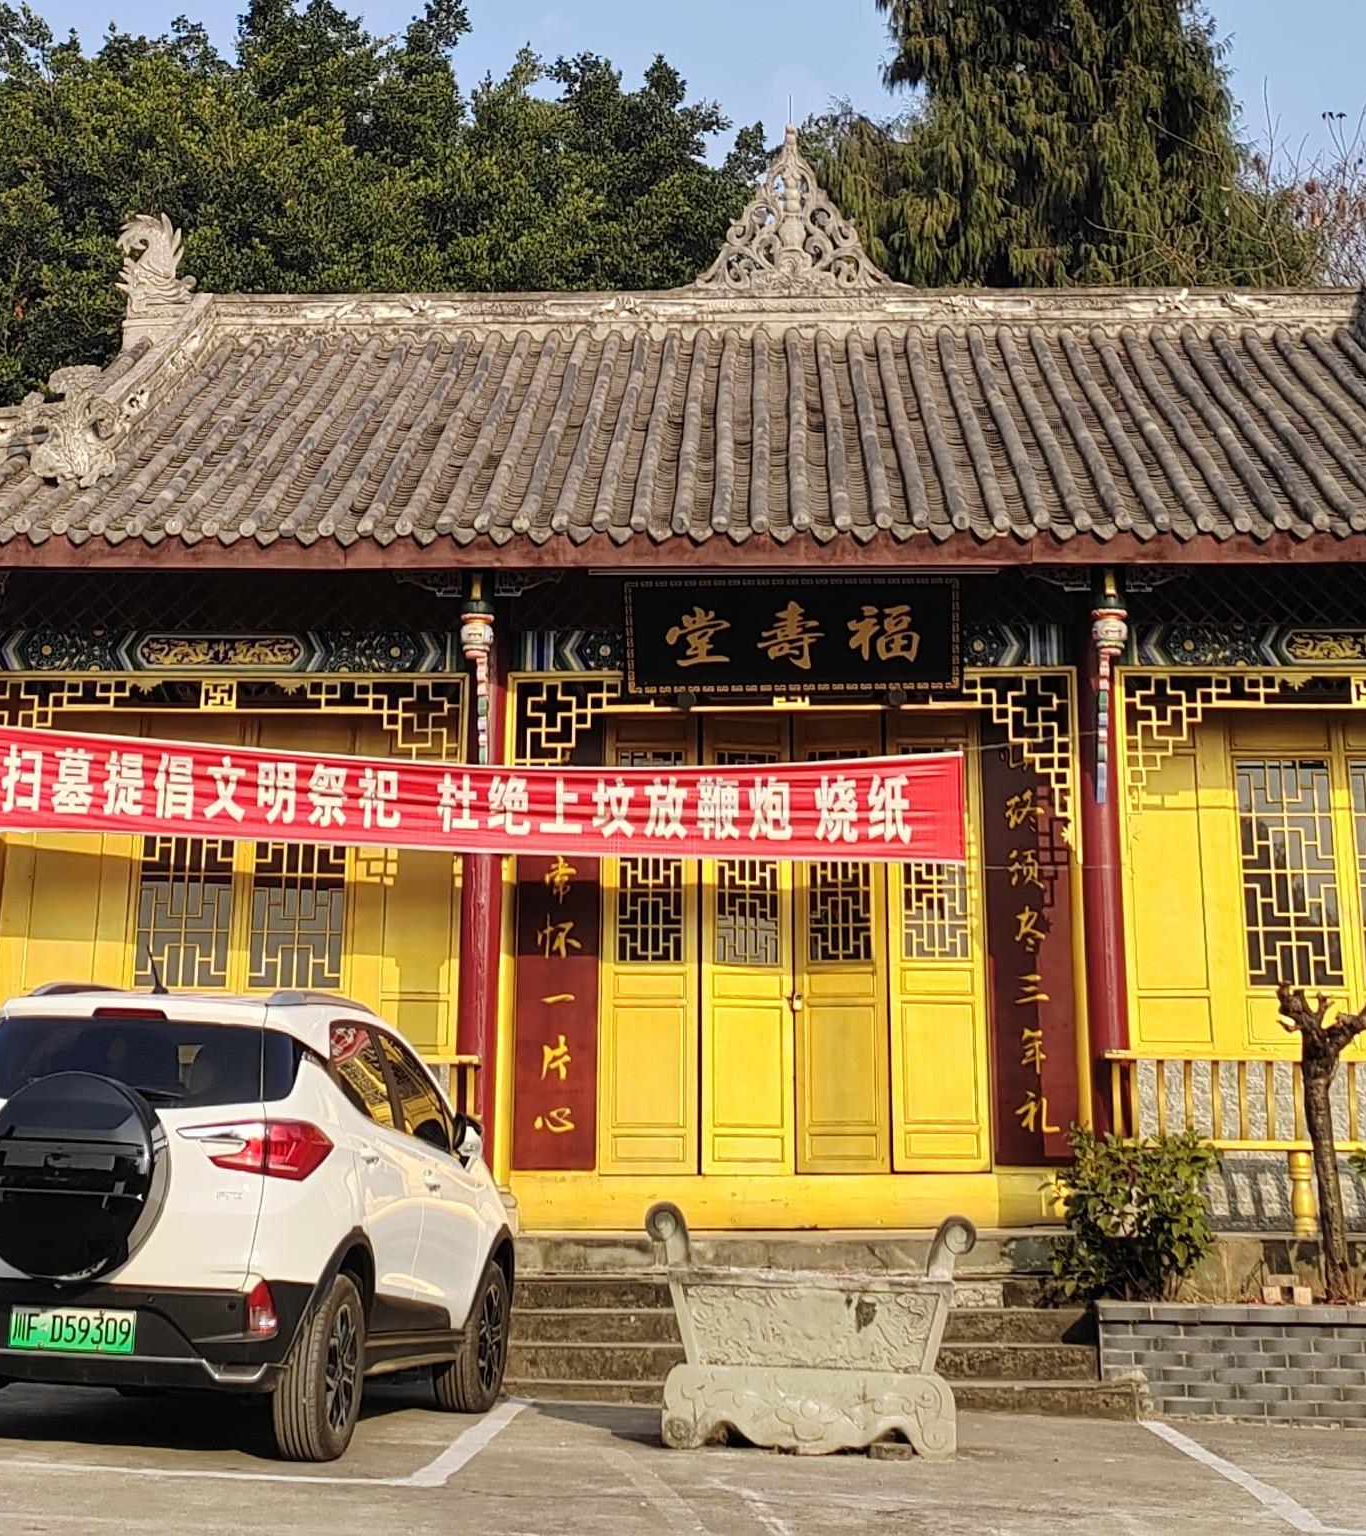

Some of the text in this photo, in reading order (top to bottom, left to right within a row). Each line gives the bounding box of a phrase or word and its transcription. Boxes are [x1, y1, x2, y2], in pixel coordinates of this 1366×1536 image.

[1, 743, 912, 844] 扫墓提倡文明祭祀 杜绝上坟放鞭炮 烧纸
